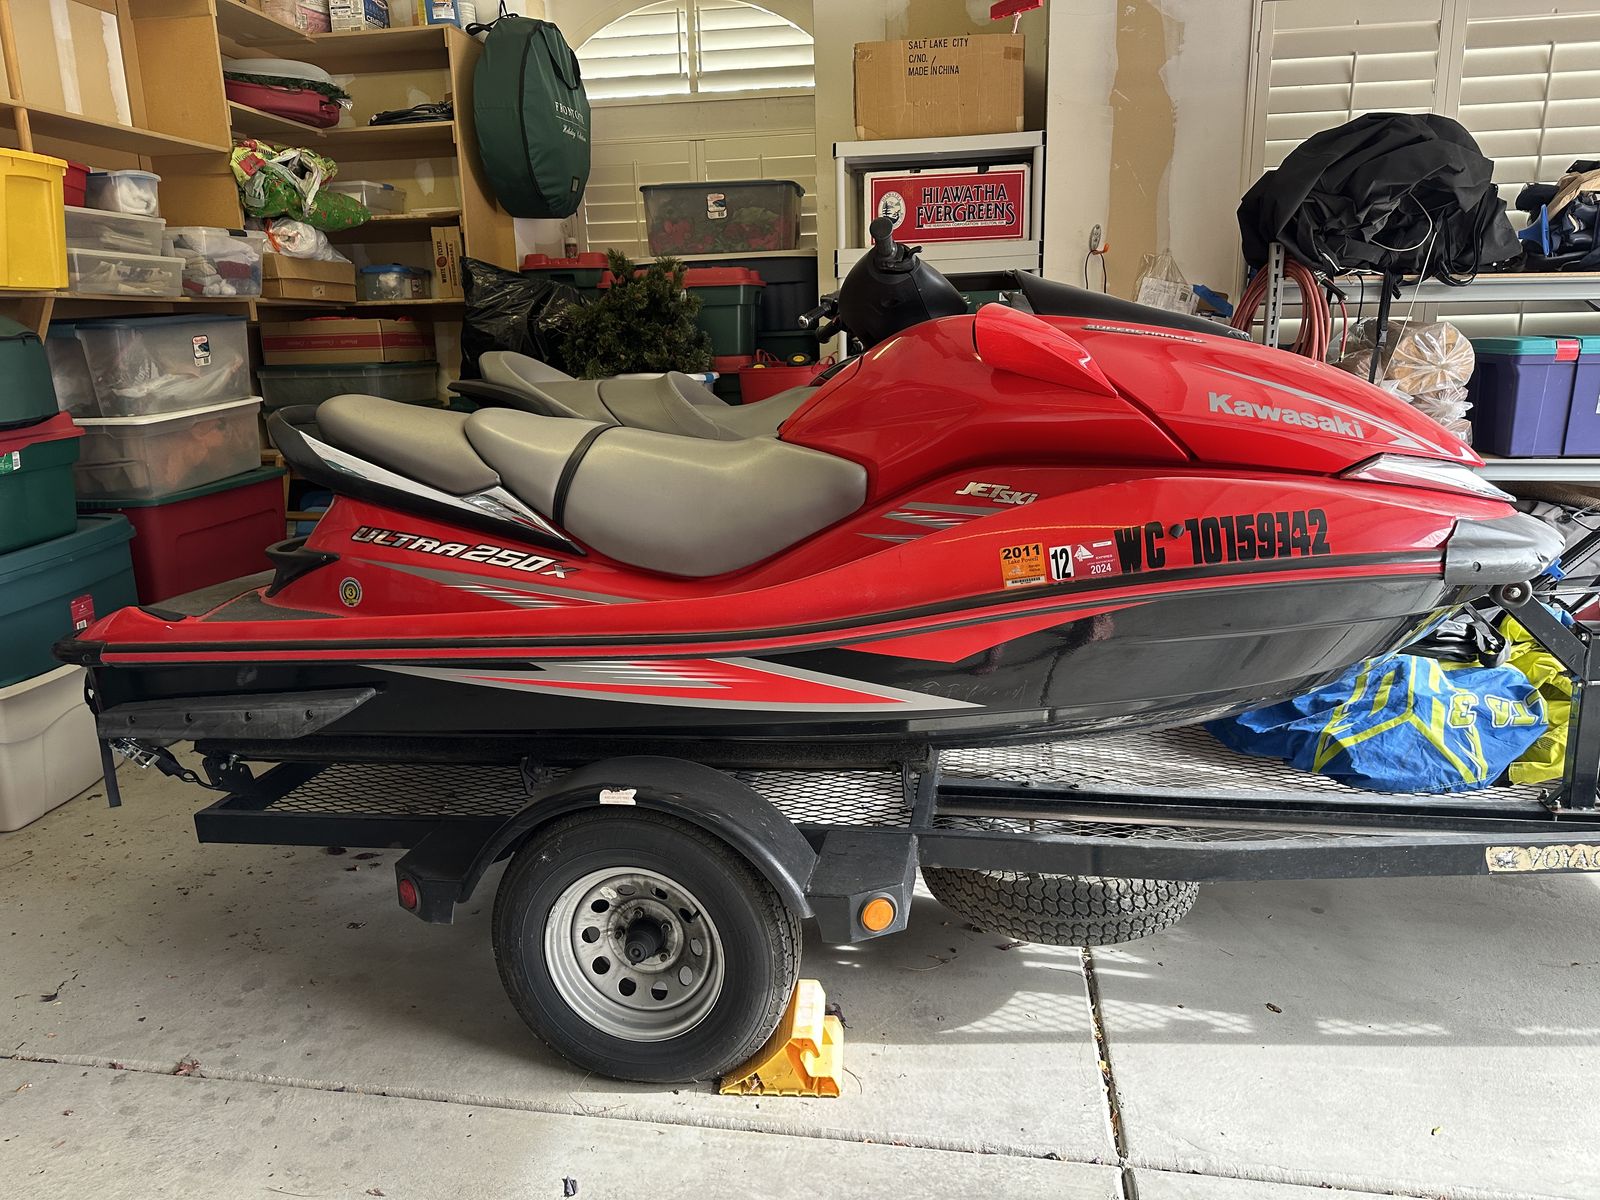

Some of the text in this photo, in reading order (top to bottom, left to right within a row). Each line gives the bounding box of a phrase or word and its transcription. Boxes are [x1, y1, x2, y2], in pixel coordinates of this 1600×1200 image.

[908, 38, 968, 50] SALT LAKE CITY
[908, 53, 928, 63] C/NO.
[908, 66, 928, 76] MADE
[938, 65, 959, 75] CHINA
[922, 184, 1008, 205] HIAWATHA
[915, 202, 1016, 229] EVERGREENS
[1208, 392, 1364, 439] Kawasaki
[1002, 544, 1040, 560] 2011
[1114, 521, 1166, 574] WC
[1051, 547, 1072, 580] 12
[1090, 563, 1112, 575] 2024
